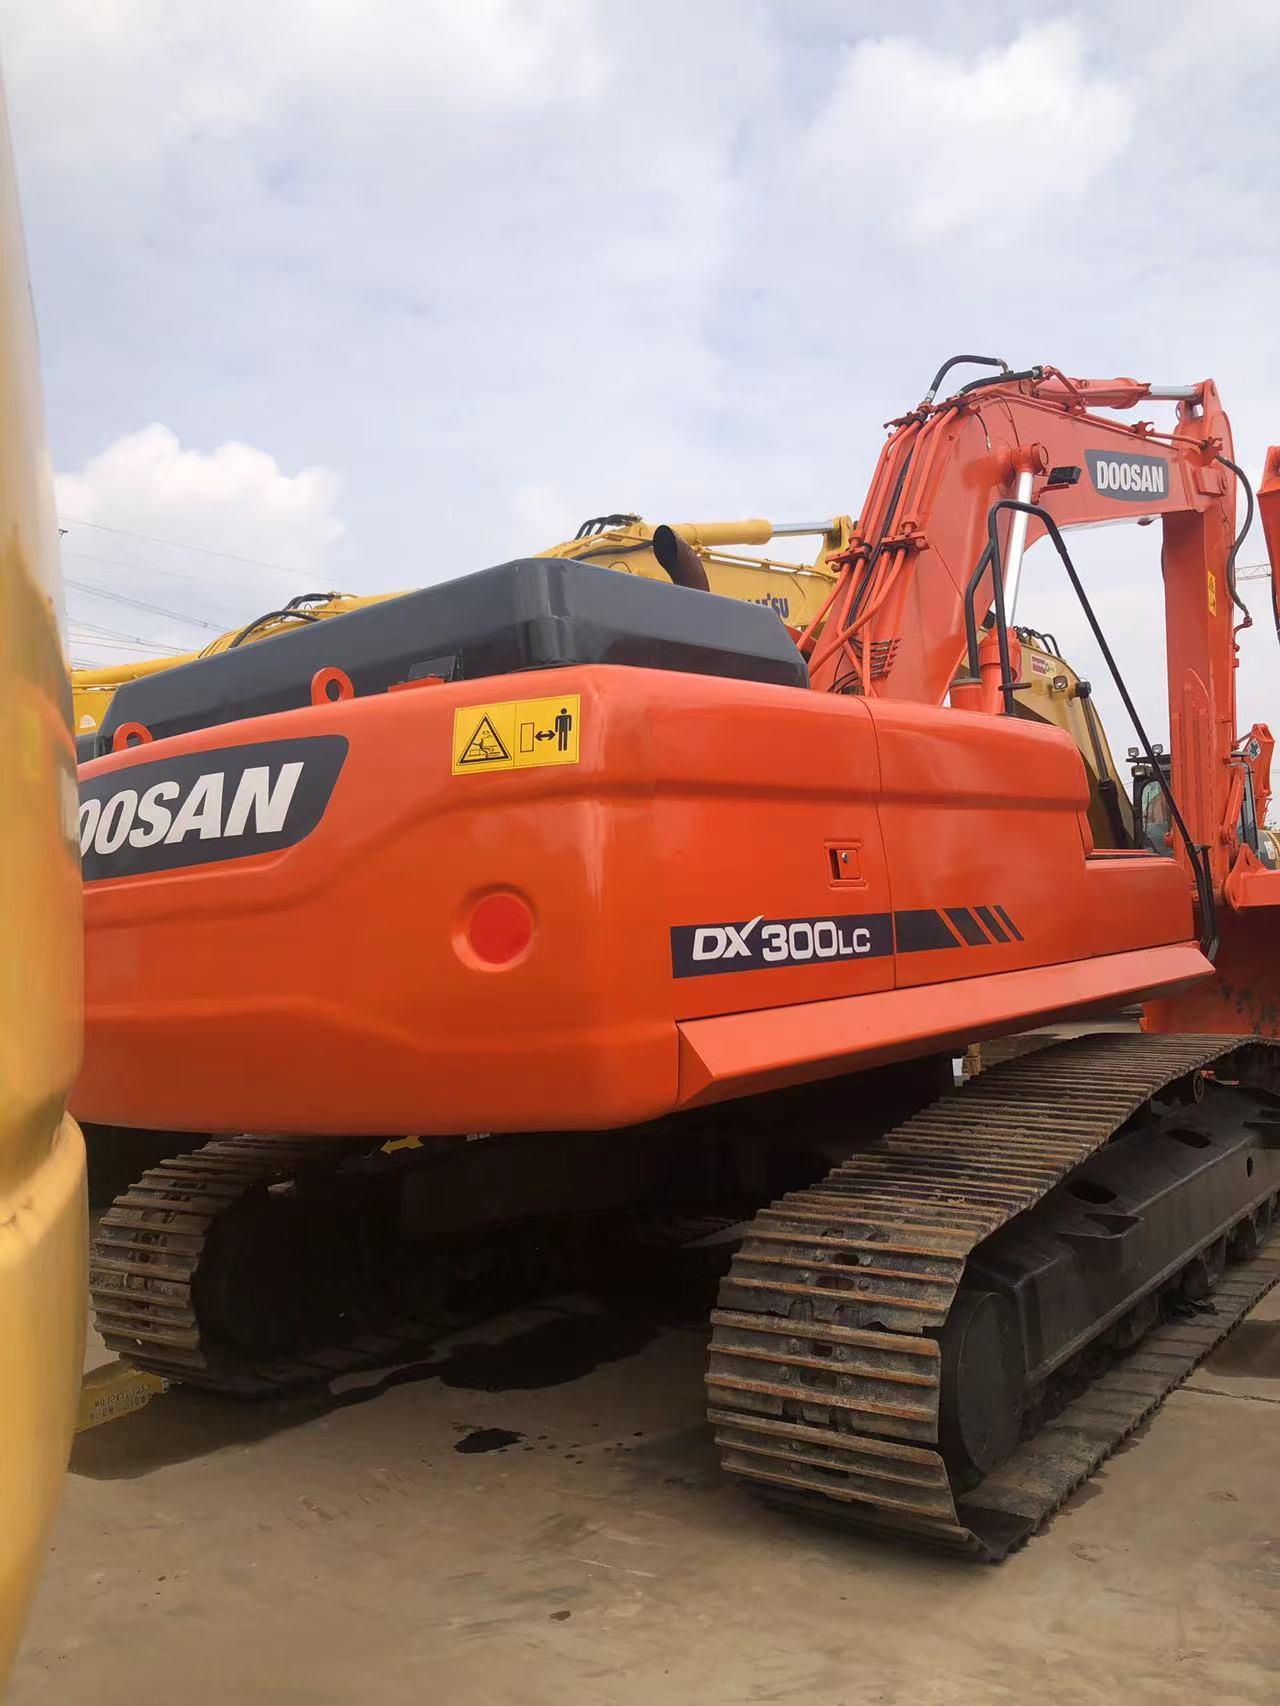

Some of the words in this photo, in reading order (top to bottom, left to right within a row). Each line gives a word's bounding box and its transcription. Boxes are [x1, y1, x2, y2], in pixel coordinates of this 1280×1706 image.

[1096, 460, 1164, 493] DOOSAN
[78, 761, 304, 858] OOSAN
[692, 914, 764, 961] DX
